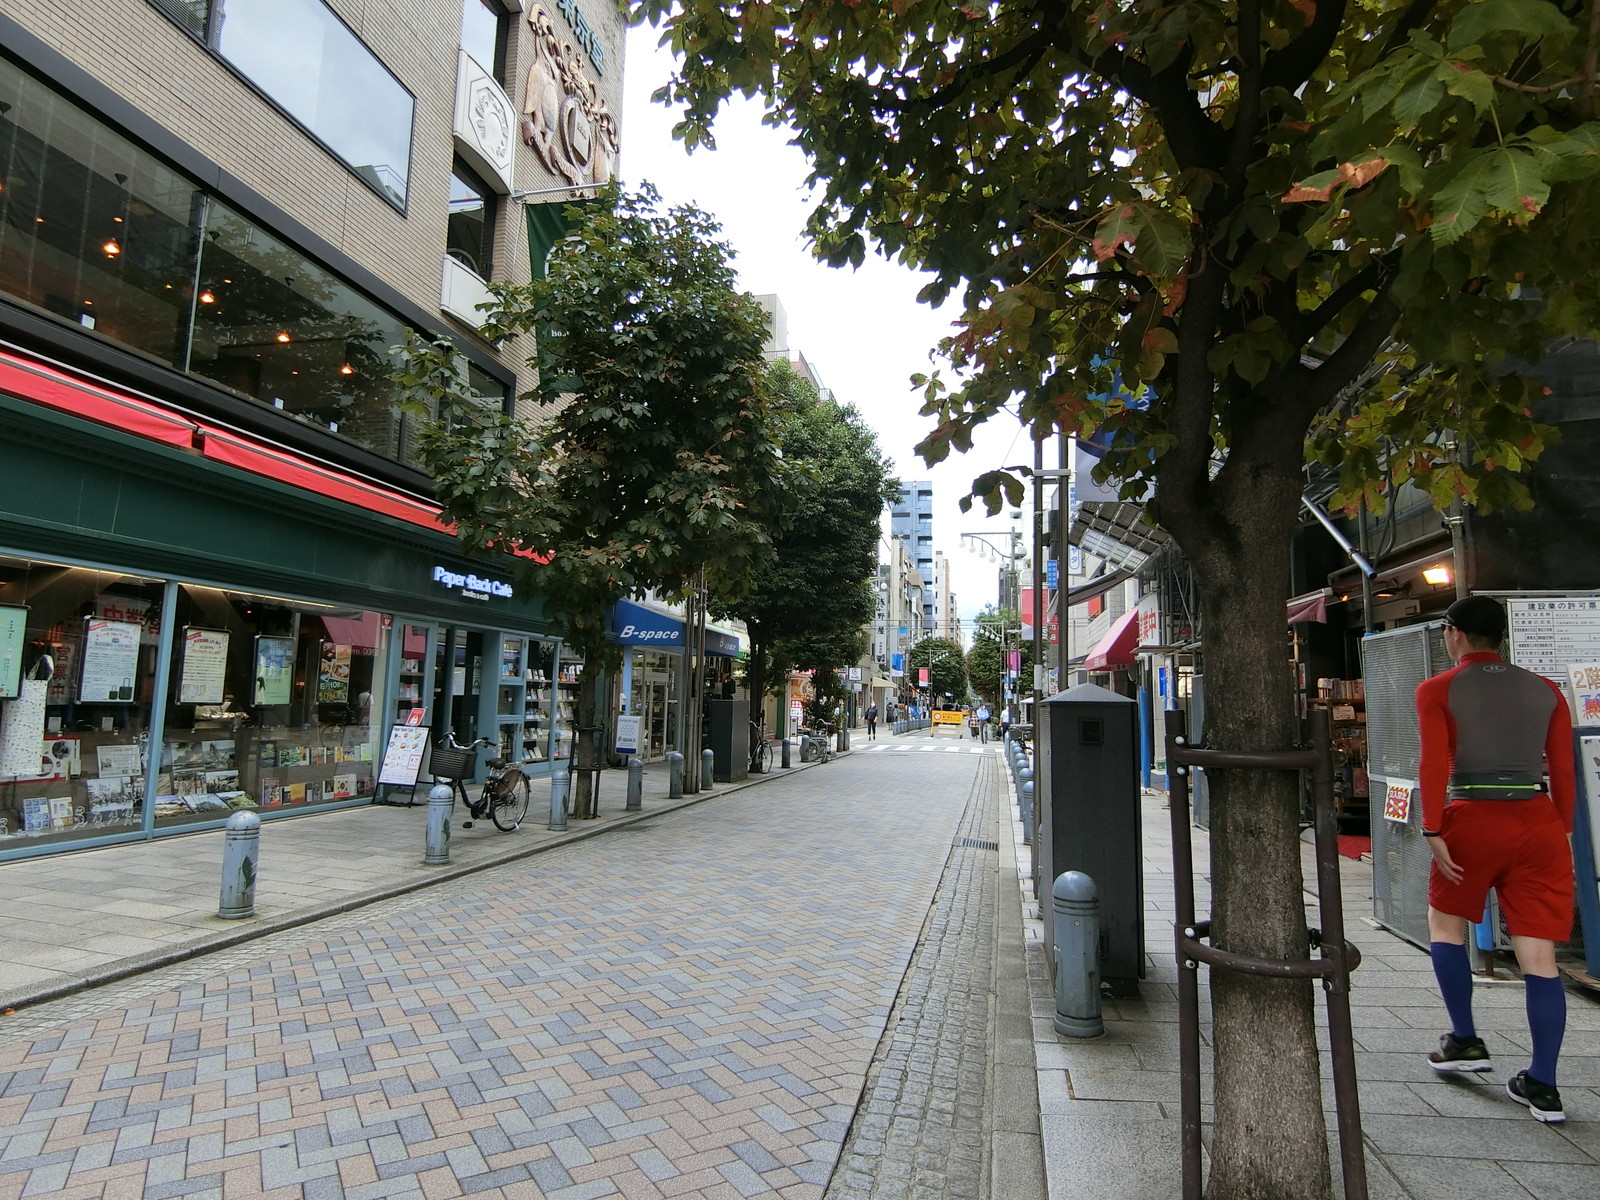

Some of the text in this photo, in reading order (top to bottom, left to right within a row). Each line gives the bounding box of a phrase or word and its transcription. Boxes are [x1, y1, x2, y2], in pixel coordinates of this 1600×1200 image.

[434, 566, 465, 588] Paper
[467, 574, 492, 593] Back
[620, 625, 679, 640] B-space
[720, 638, 736, 651] B-space
